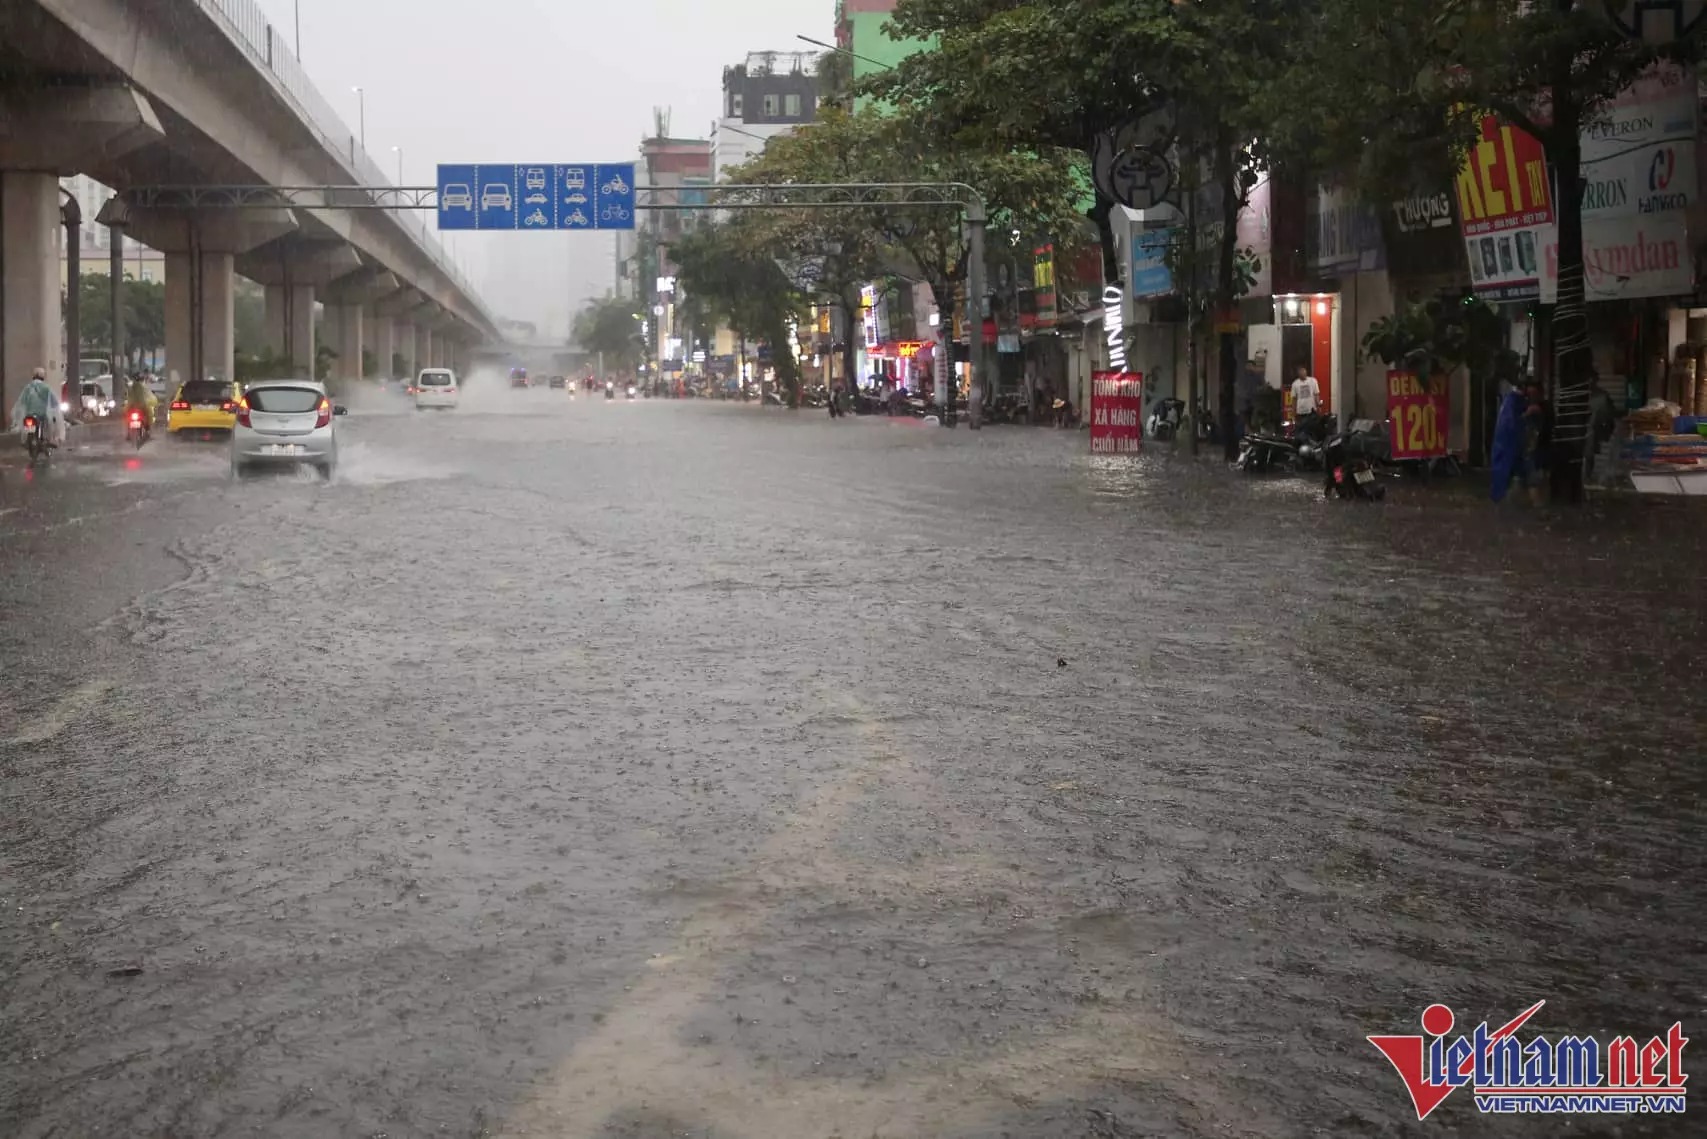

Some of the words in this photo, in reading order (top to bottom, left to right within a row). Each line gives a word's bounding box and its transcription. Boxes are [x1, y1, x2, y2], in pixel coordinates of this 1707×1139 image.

[1591, 117, 1653, 139] EVERON
[1093, 375, 1118, 397] TỔNG
[1120, 380, 1141, 398] KHO
[1095, 404, 1108, 425] XẢ
[1111, 406, 1136, 426] HÀNG
[1117, 434, 1139, 453] NĂM
